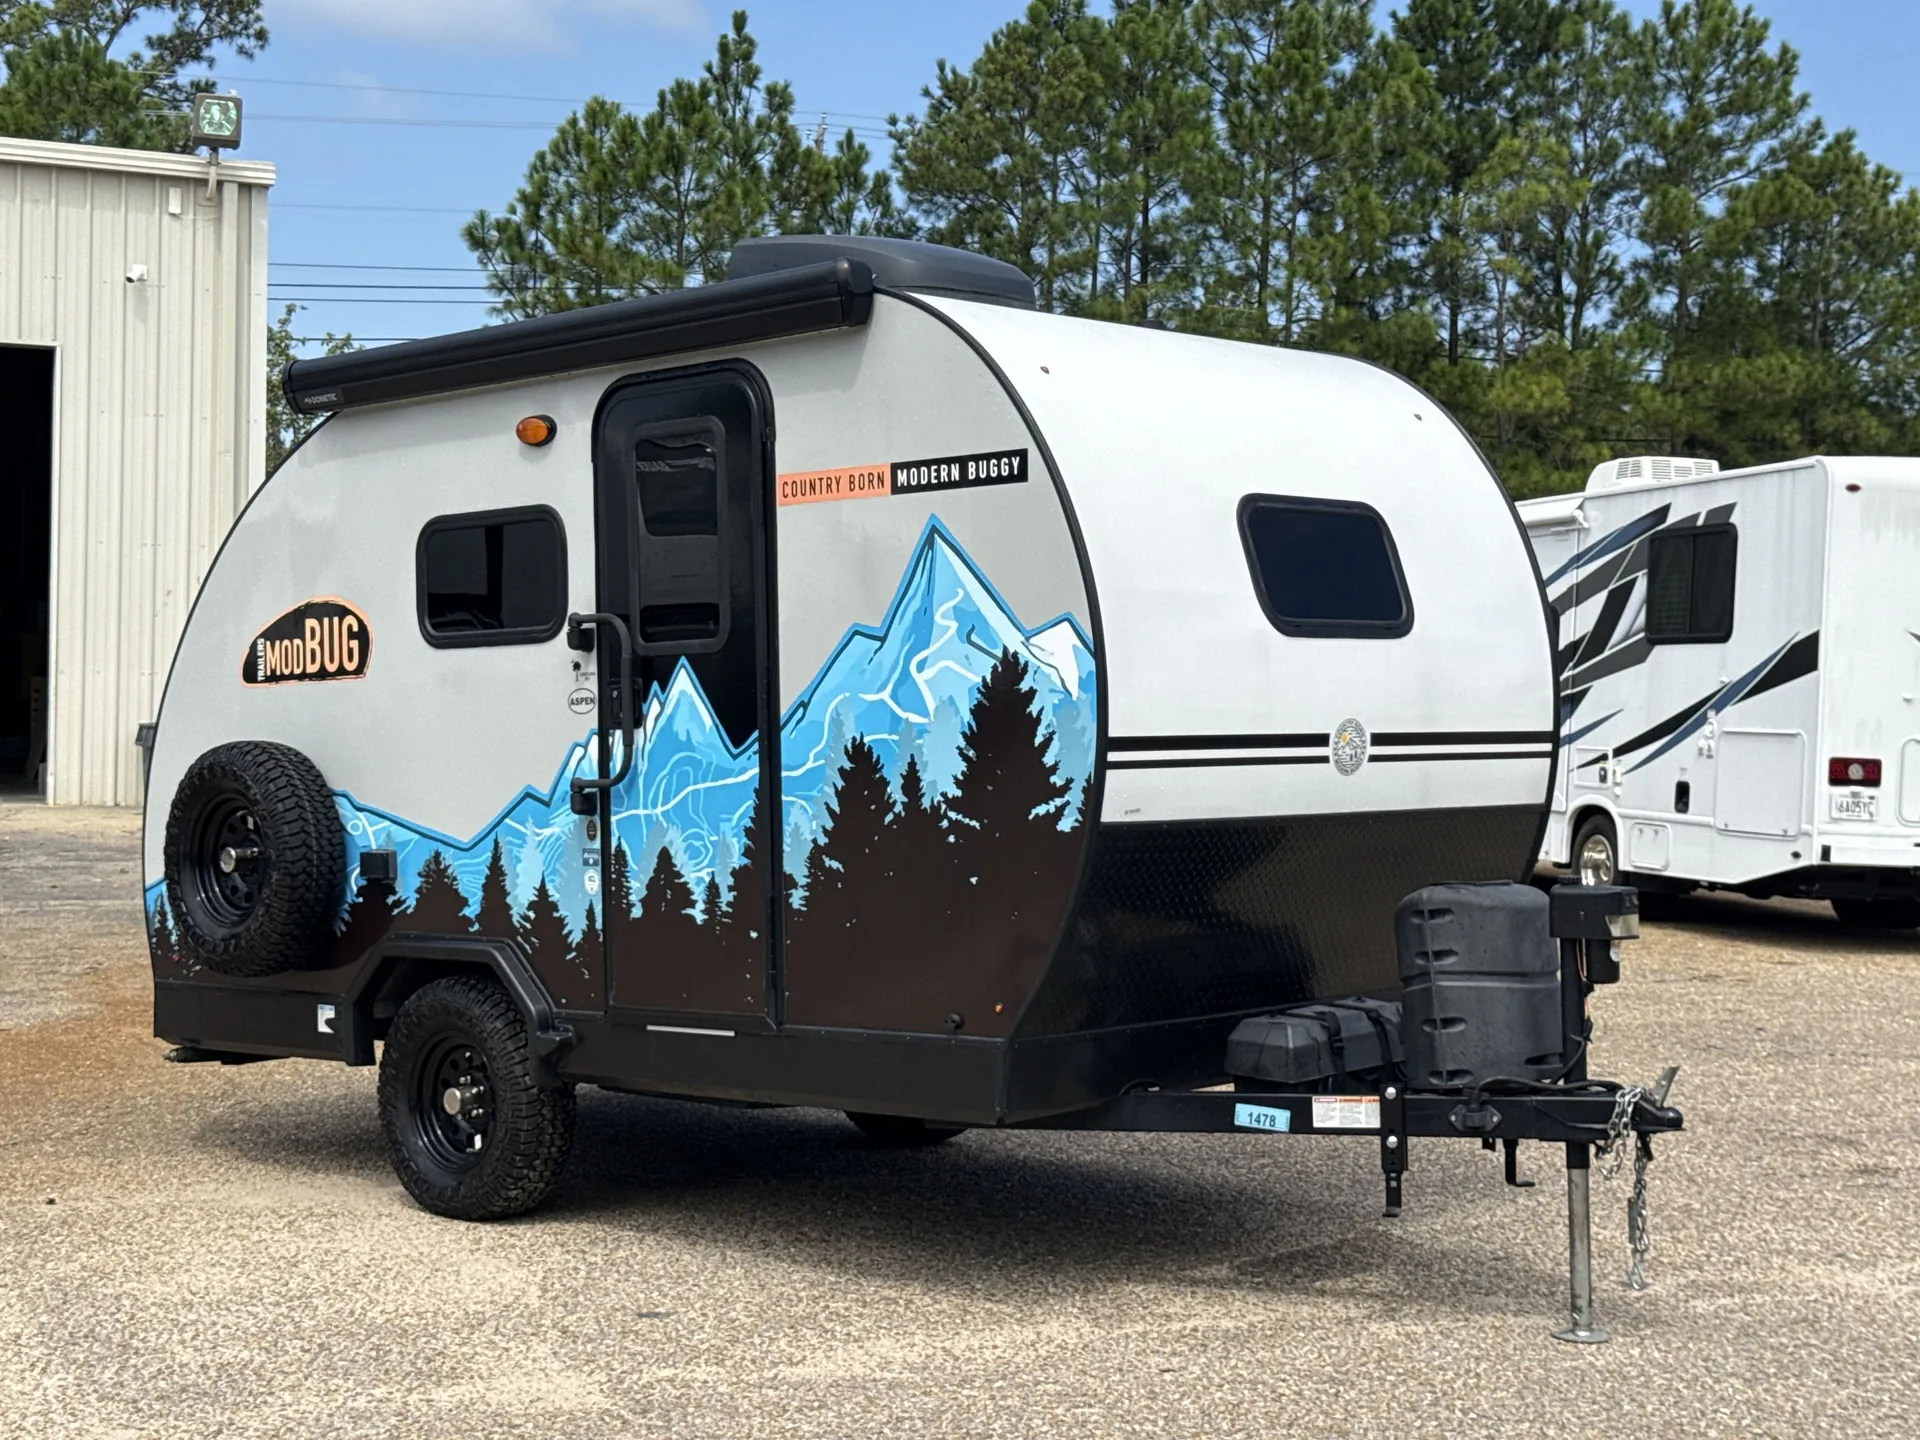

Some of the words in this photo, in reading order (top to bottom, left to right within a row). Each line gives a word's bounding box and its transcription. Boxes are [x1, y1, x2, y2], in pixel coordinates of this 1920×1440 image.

[311, 393, 338, 404] DOMETIC
[782, 475, 842, 498] COUNTRY
[849, 471, 885, 492] BORN
[897, 462, 960, 487] MODERN
[968, 456, 1020, 480] BUGGY
[257, 638, 266, 682] TRAILERS
[570, 696, 595, 706] ASPEN
[1247, 1112, 1277, 1128] 1478
